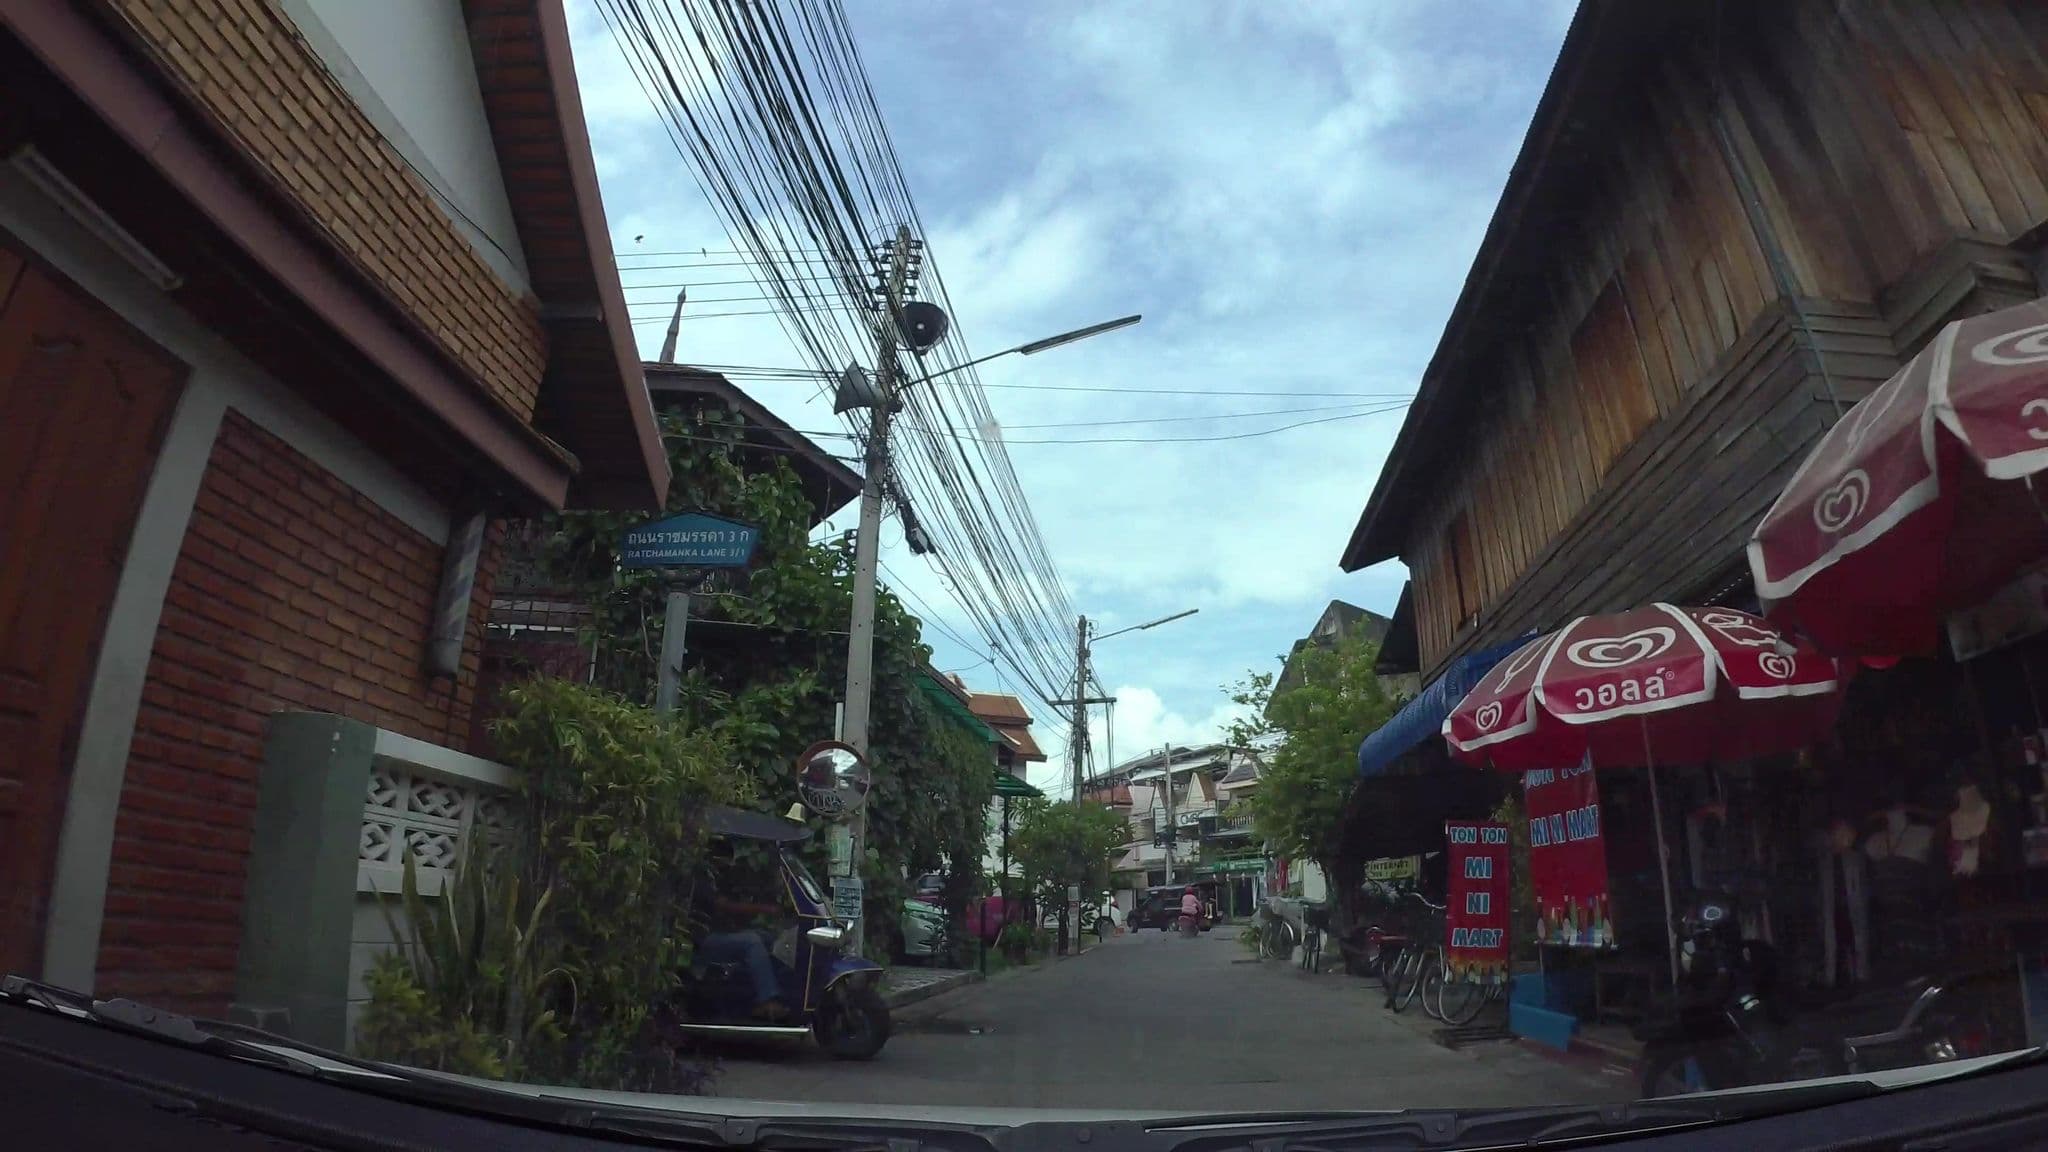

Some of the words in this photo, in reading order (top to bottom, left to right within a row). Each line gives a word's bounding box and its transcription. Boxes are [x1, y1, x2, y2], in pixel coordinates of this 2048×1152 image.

[729, 531, 735, 542] 3
[628, 548, 698, 558] RATCHAMANKA
[700, 548, 726, 557] LANE
[1566, 804, 1599, 841] MART
[1450, 827, 1477, 844] TON
[1480, 827, 1507, 844] TON
[1465, 856, 1492, 879] MI
[1466, 892, 1490, 915] NI
[1451, 928, 1503, 948] MART
